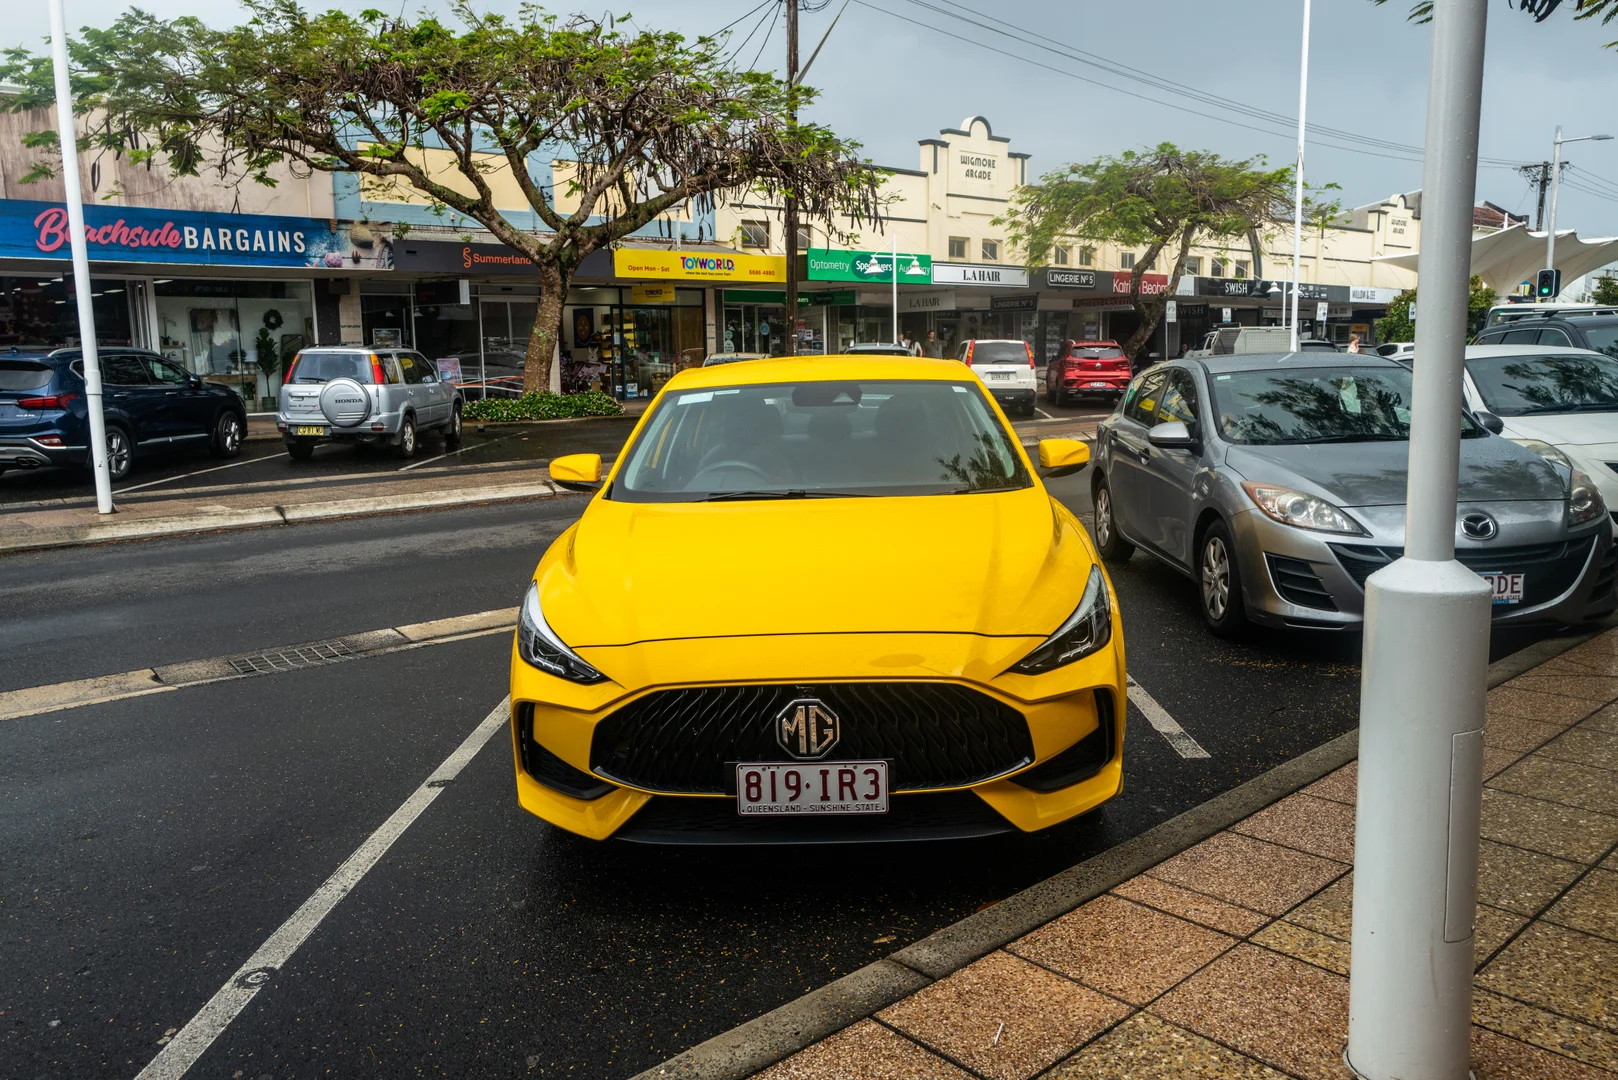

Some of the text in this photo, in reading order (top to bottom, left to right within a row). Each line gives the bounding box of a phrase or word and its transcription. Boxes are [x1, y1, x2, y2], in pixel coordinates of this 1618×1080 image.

[960, 155, 996, 168] WIGMORE
[965, 169, 992, 180] ARCADE
[183, 226, 306, 253] BARGAINS
[627, 264, 643, 272] Open
[680, 256, 734, 271] TOYWORLD
[810, 259, 850, 273] Optometry
[978, 270, 1000, 282] HAIR
[1049, 273, 1080, 284] LINGERIE
[1089, 275, 1094, 285] 5
[1113, 279, 1140, 293] Katri
[1225, 282, 1248, 294] SWISH
[922, 297, 940, 307] HAIR
[993, 300, 1020, 309] LINGERIE
[782, 705, 834, 754] MG
[747, 804, 801, 813] QUEENSLAND
[809, 803, 850, 812] SUNSHINE
[855, 803, 880, 811] STATE
